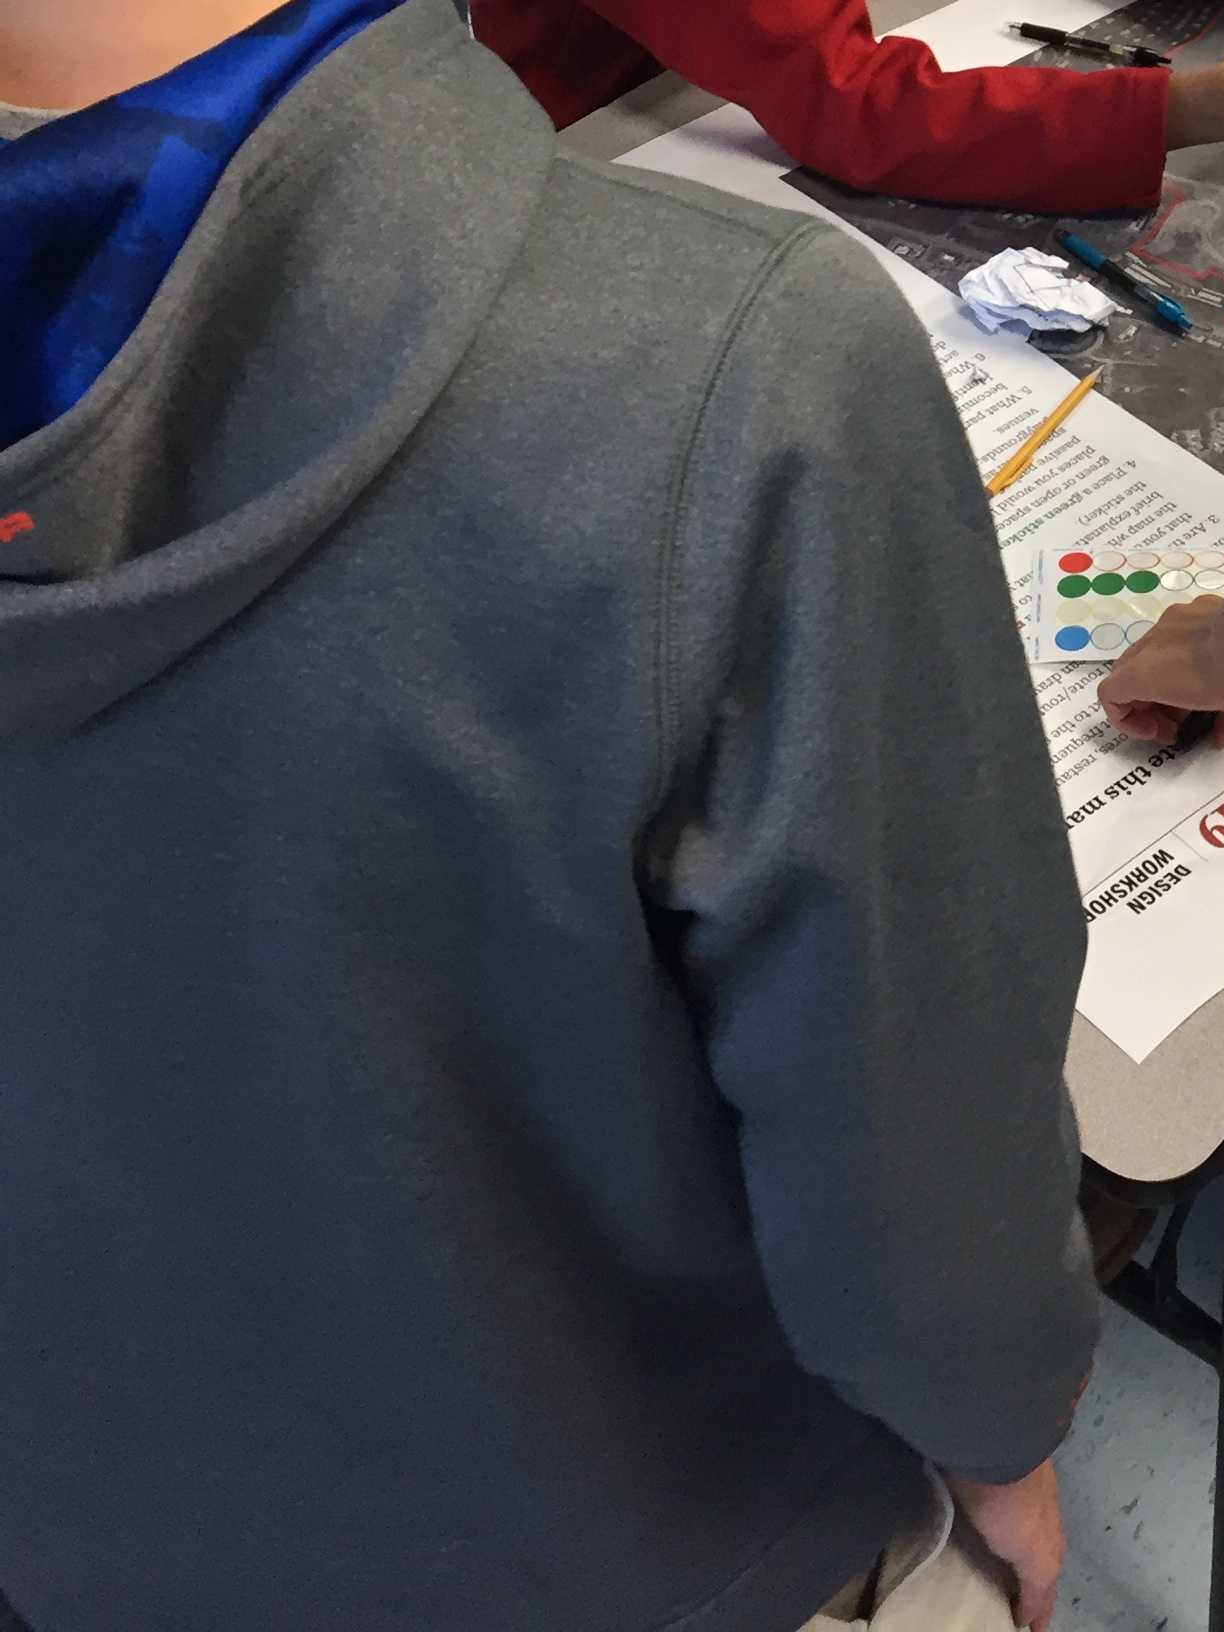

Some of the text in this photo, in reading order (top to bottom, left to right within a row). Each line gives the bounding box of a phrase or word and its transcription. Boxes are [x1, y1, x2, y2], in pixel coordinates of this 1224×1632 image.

[985, 395, 1022, 415] What
[994, 408, 1039, 433] venues.
[1033, 435, 1081, 465] passive
[1075, 455, 1109, 479] green
[996, 445, 1096, 511] places you would
[1062, 479, 1076, 490] or
[1092, 467, 1128, 489] Place
[1124, 481, 1146, 495] the
[1031, 487, 1062, 507] open
[1043, 492, 1083, 519] green
[1130, 491, 1164, 515] brief
[1154, 502, 1177, 517] the
[1128, 516, 1156, 534] map
[1165, 513, 1192, 531] that
[1183, 522, 1206, 539] Are
[1142, 527, 1167, 546] you
[1074, 711, 1091, 721] to
[1051, 721, 1076, 737] the
[1051, 727, 1106, 764] frequen
[1053, 732, 1129, 787] ores, restau
[1104, 762, 1151, 799] this
[1126, 864, 1192, 914] DESIGN
